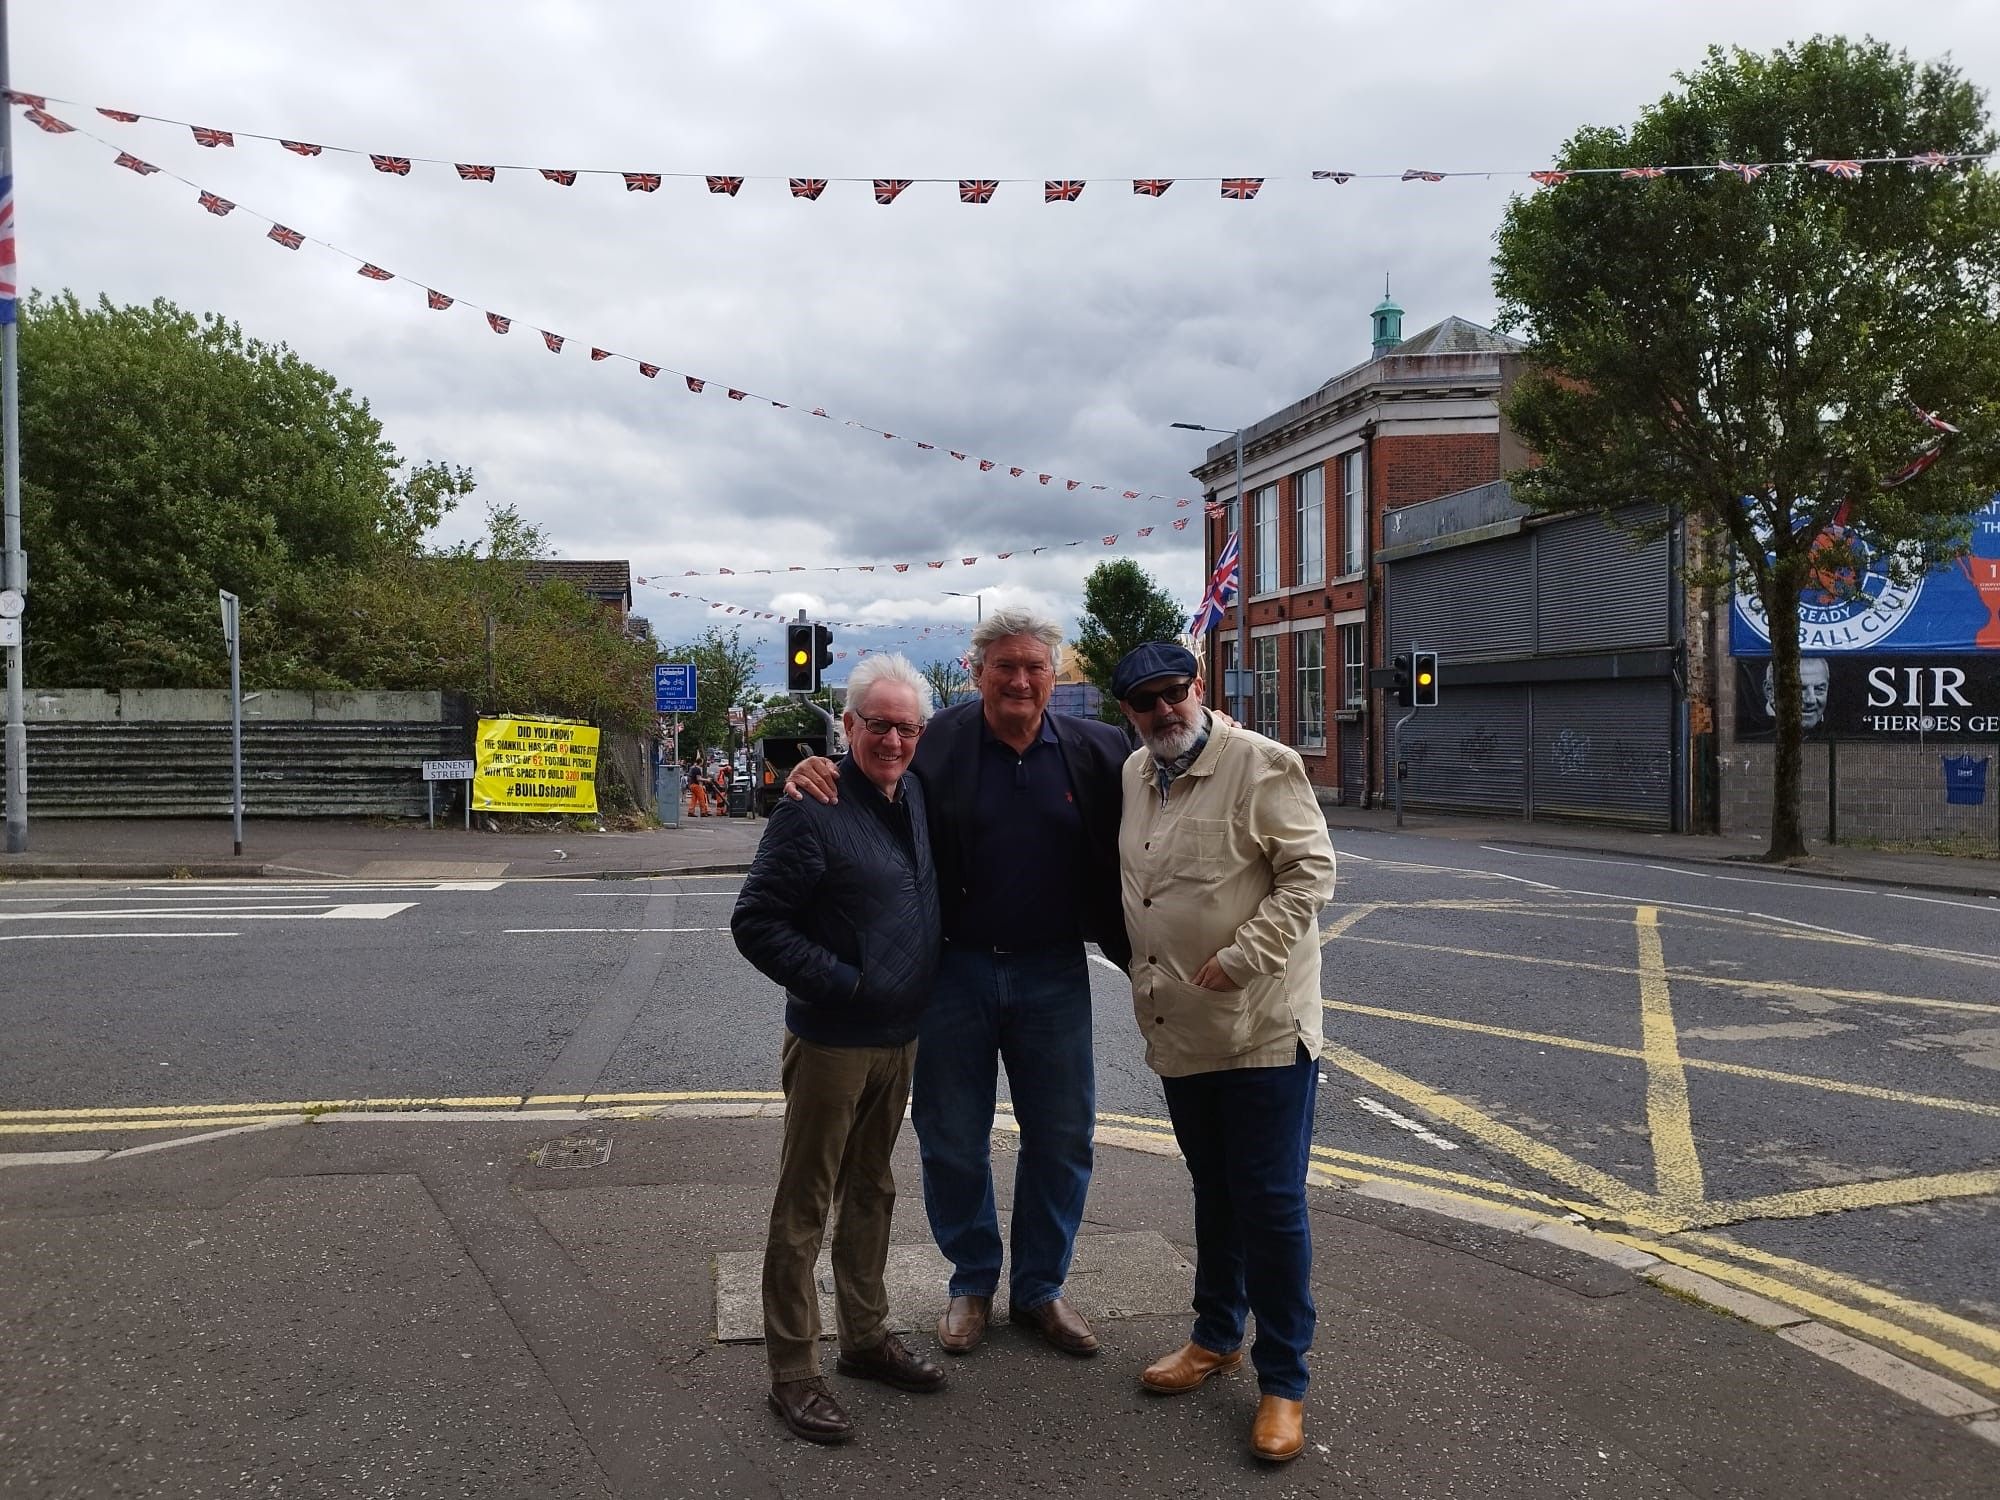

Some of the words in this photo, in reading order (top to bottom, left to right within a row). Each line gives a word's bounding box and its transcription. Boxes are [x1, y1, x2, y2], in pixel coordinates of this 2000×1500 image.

[1799, 606, 1851, 623] READY
[1868, 667, 1973, 707] SIR
[517, 726, 532, 738] DID
[534, 727, 548, 739] YOU
[550, 728, 575, 741] KNOW?
[484, 739, 496, 750] THE
[528, 741, 542, 752] HAS
[425, 761, 470, 770] TENNENT
[492, 753, 503, 764] THE
[505, 754, 521, 765] SIZE
[522, 755, 532, 765] OF
[532, 755, 543, 765] 62
[544, 756, 571, 767] FOOTBALL
[484, 766, 501, 777] WITH
[503, 767, 514, 778] THE
[516, 768, 537, 779] SPACE
[538, 769, 546, 779] TO
[505, 783, 577, 799] #BUILDshankill
